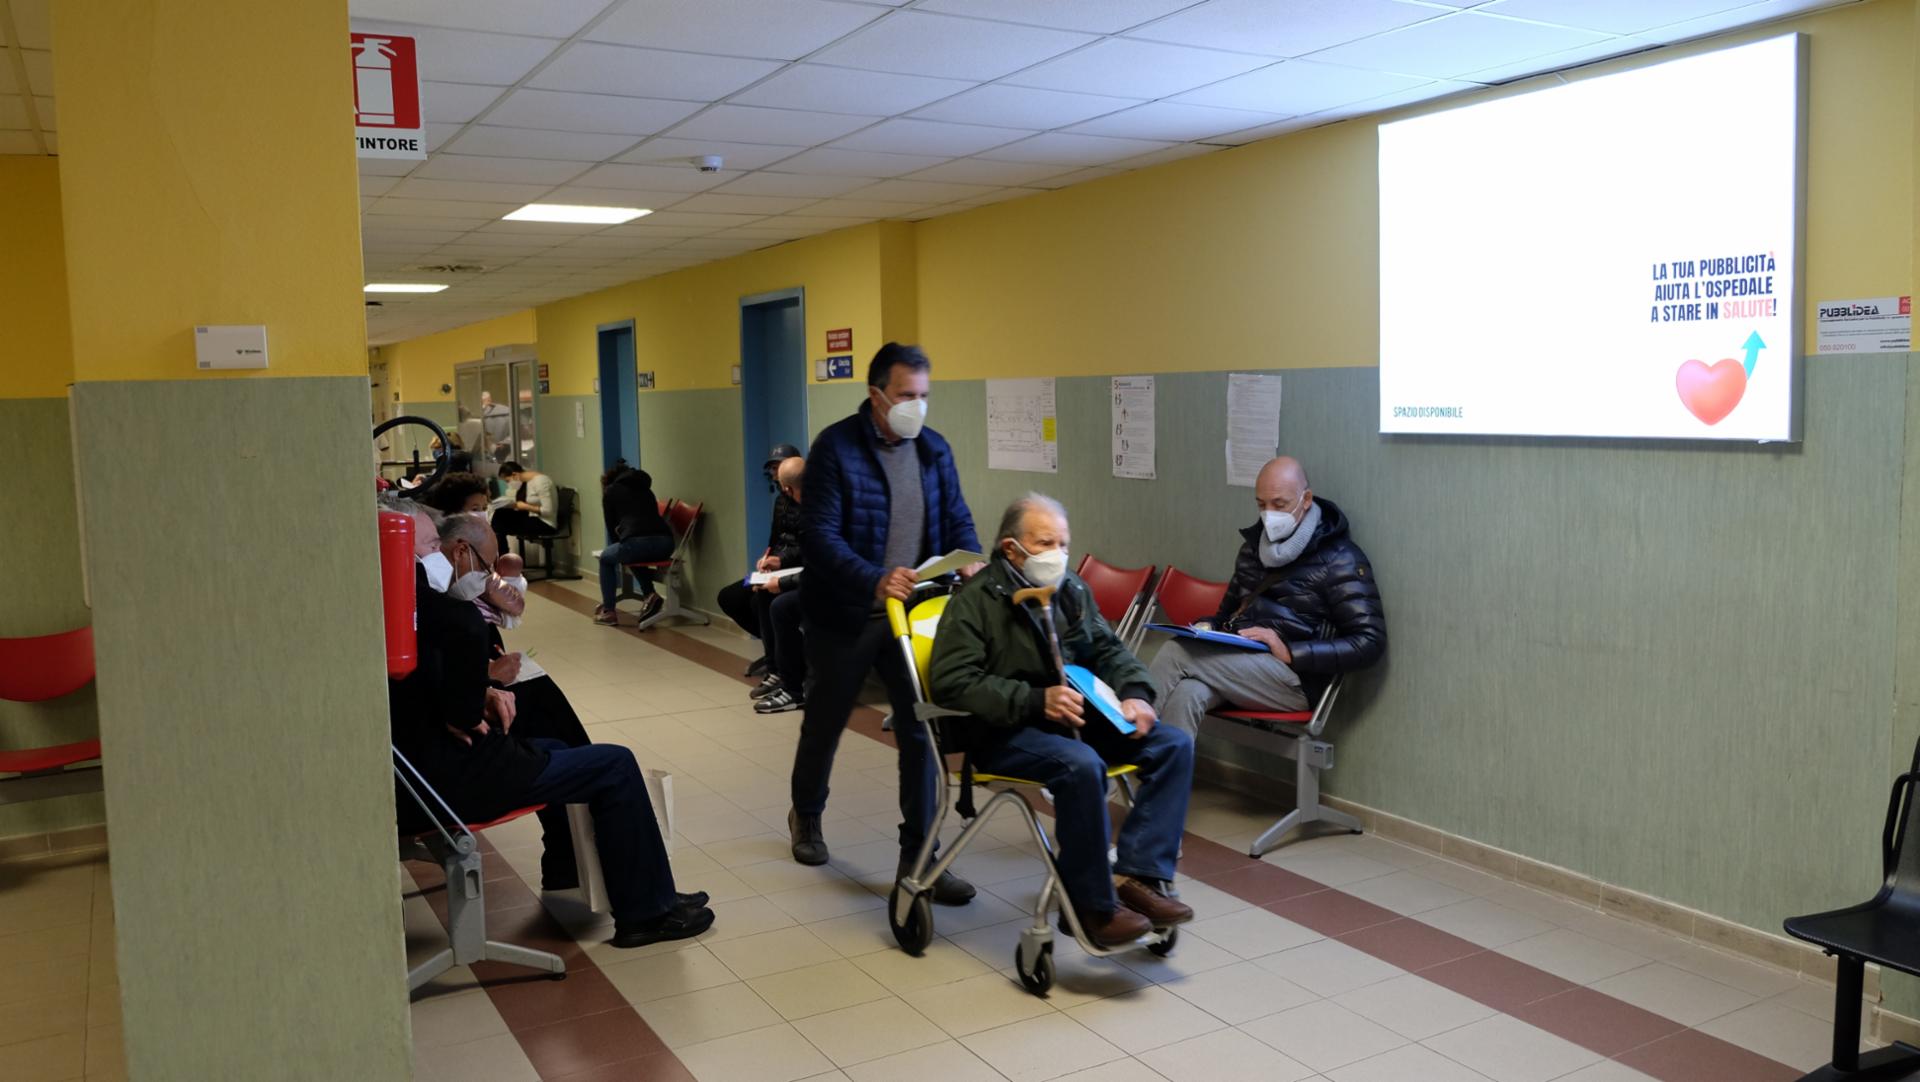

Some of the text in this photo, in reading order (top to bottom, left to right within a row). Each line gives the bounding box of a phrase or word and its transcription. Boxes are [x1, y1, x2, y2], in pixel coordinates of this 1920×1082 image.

[355, 137, 419, 151] INTORE
[1653, 263, 1668, 281] LA
[1672, 261, 1695, 279] TUA
[1655, 276, 1773, 301] AIUTA L'OSPEDALE
[1651, 298, 1777, 322] A STARE IN SALUTE!
[1393, 406, 1464, 418] SPAZIO DISPONIBILE
